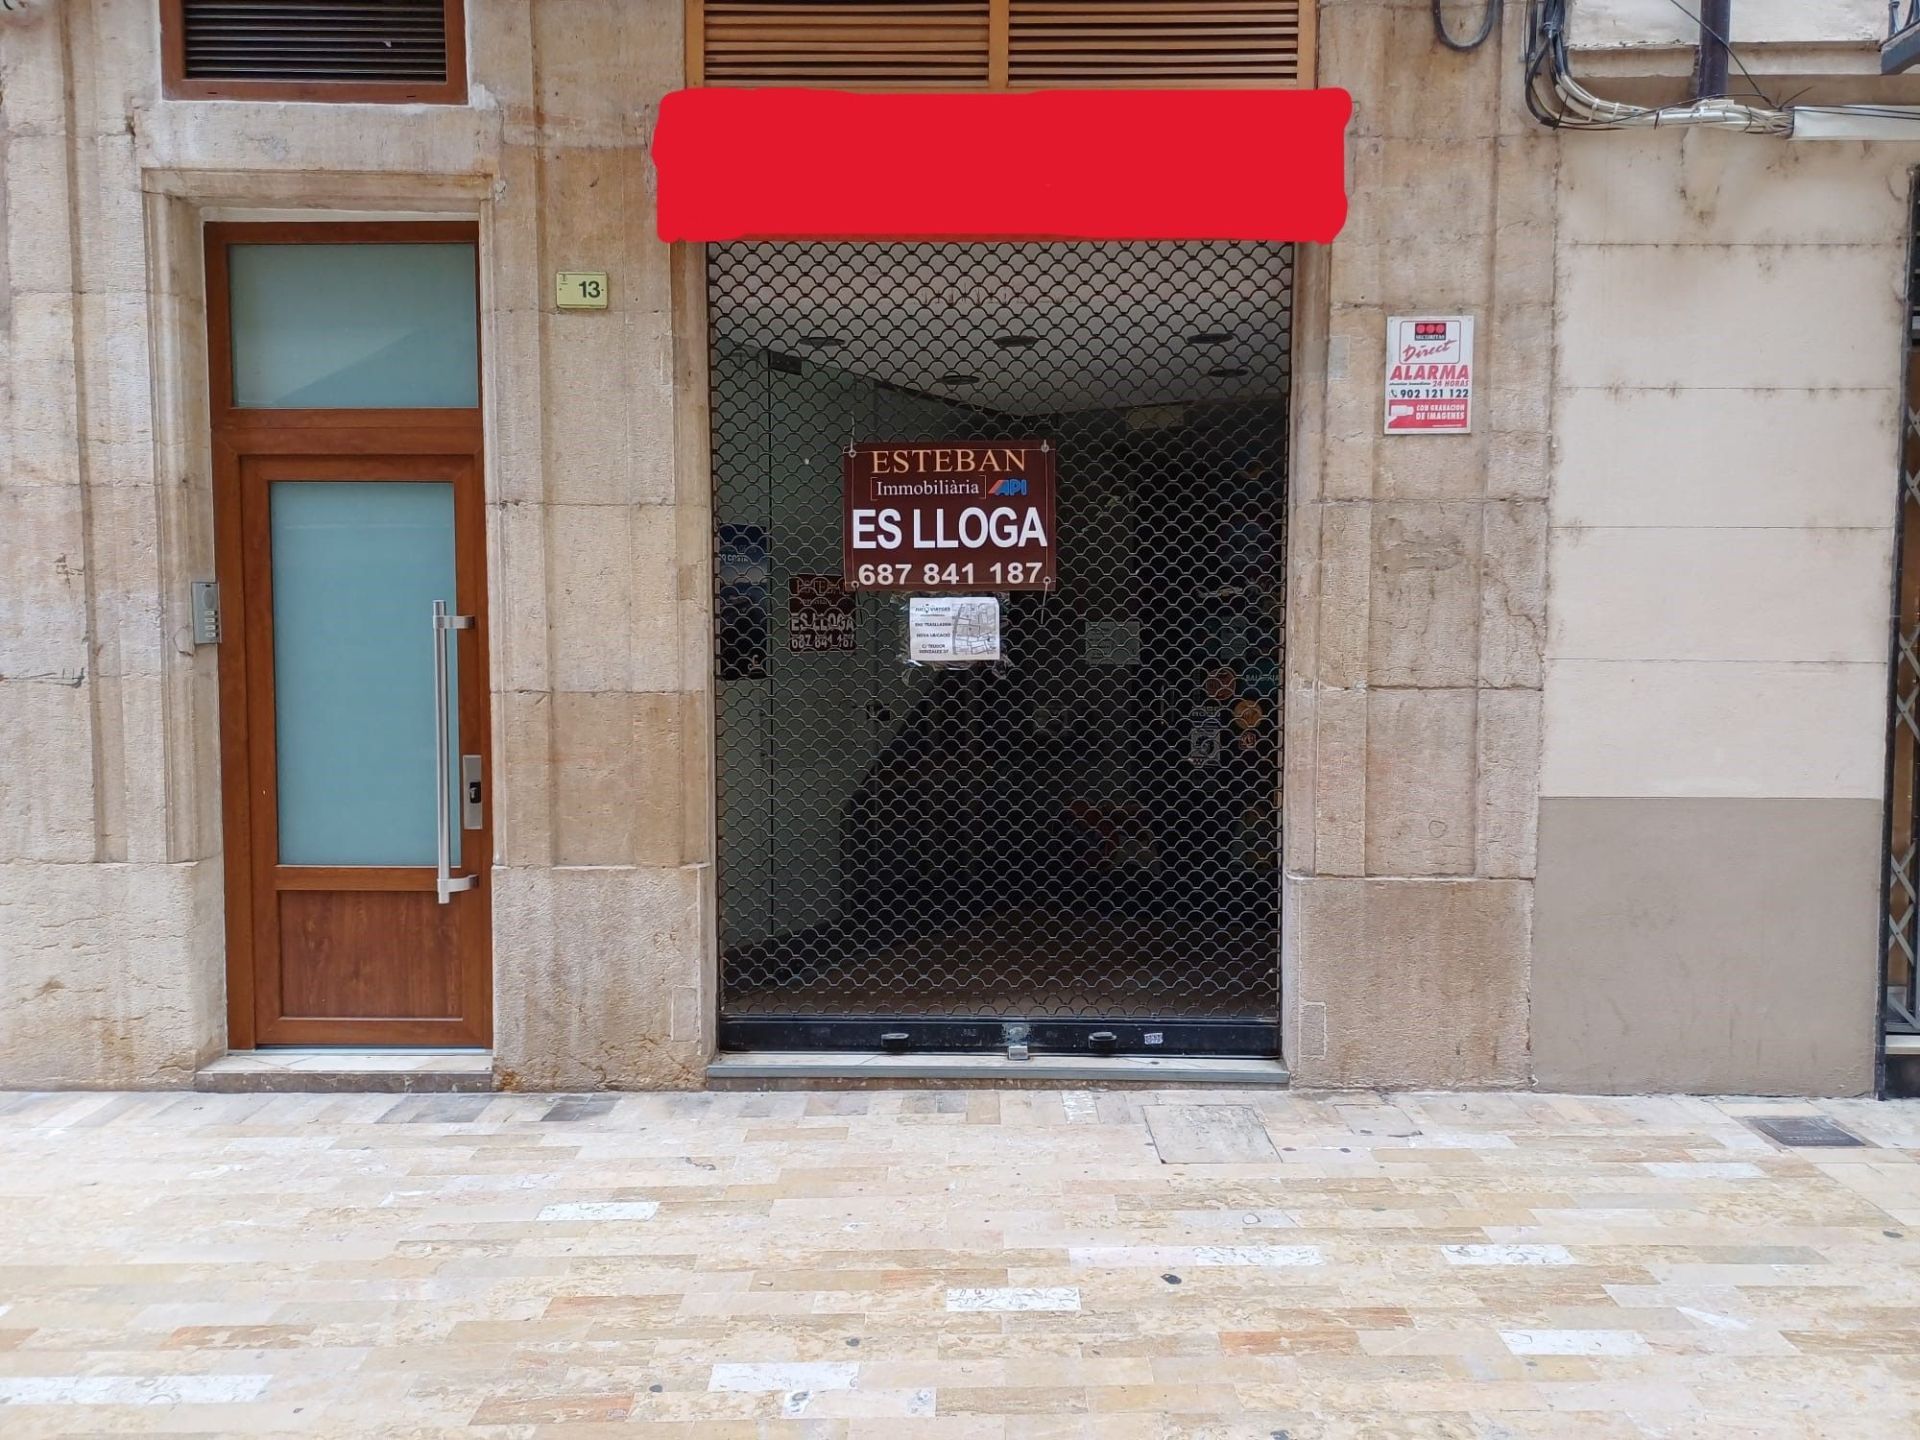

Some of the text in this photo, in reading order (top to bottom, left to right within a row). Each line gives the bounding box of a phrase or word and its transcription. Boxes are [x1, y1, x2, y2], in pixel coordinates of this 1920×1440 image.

[578, 280, 601, 298] 13
[1402, 339, 1457, 362] Direct
[1389, 364, 1469, 380] ALARMA
[1400, 389, 1469, 399] 902 121 122
[1415, 411, 1465, 420] DE IMAGENES
[871, 449, 1026, 474] ESTEBAN
[876, 479, 1028, 496] Immobiliària API
[852, 507, 1048, 549] ES LLOGA
[858, 562, 1043, 585] 687 841 187
